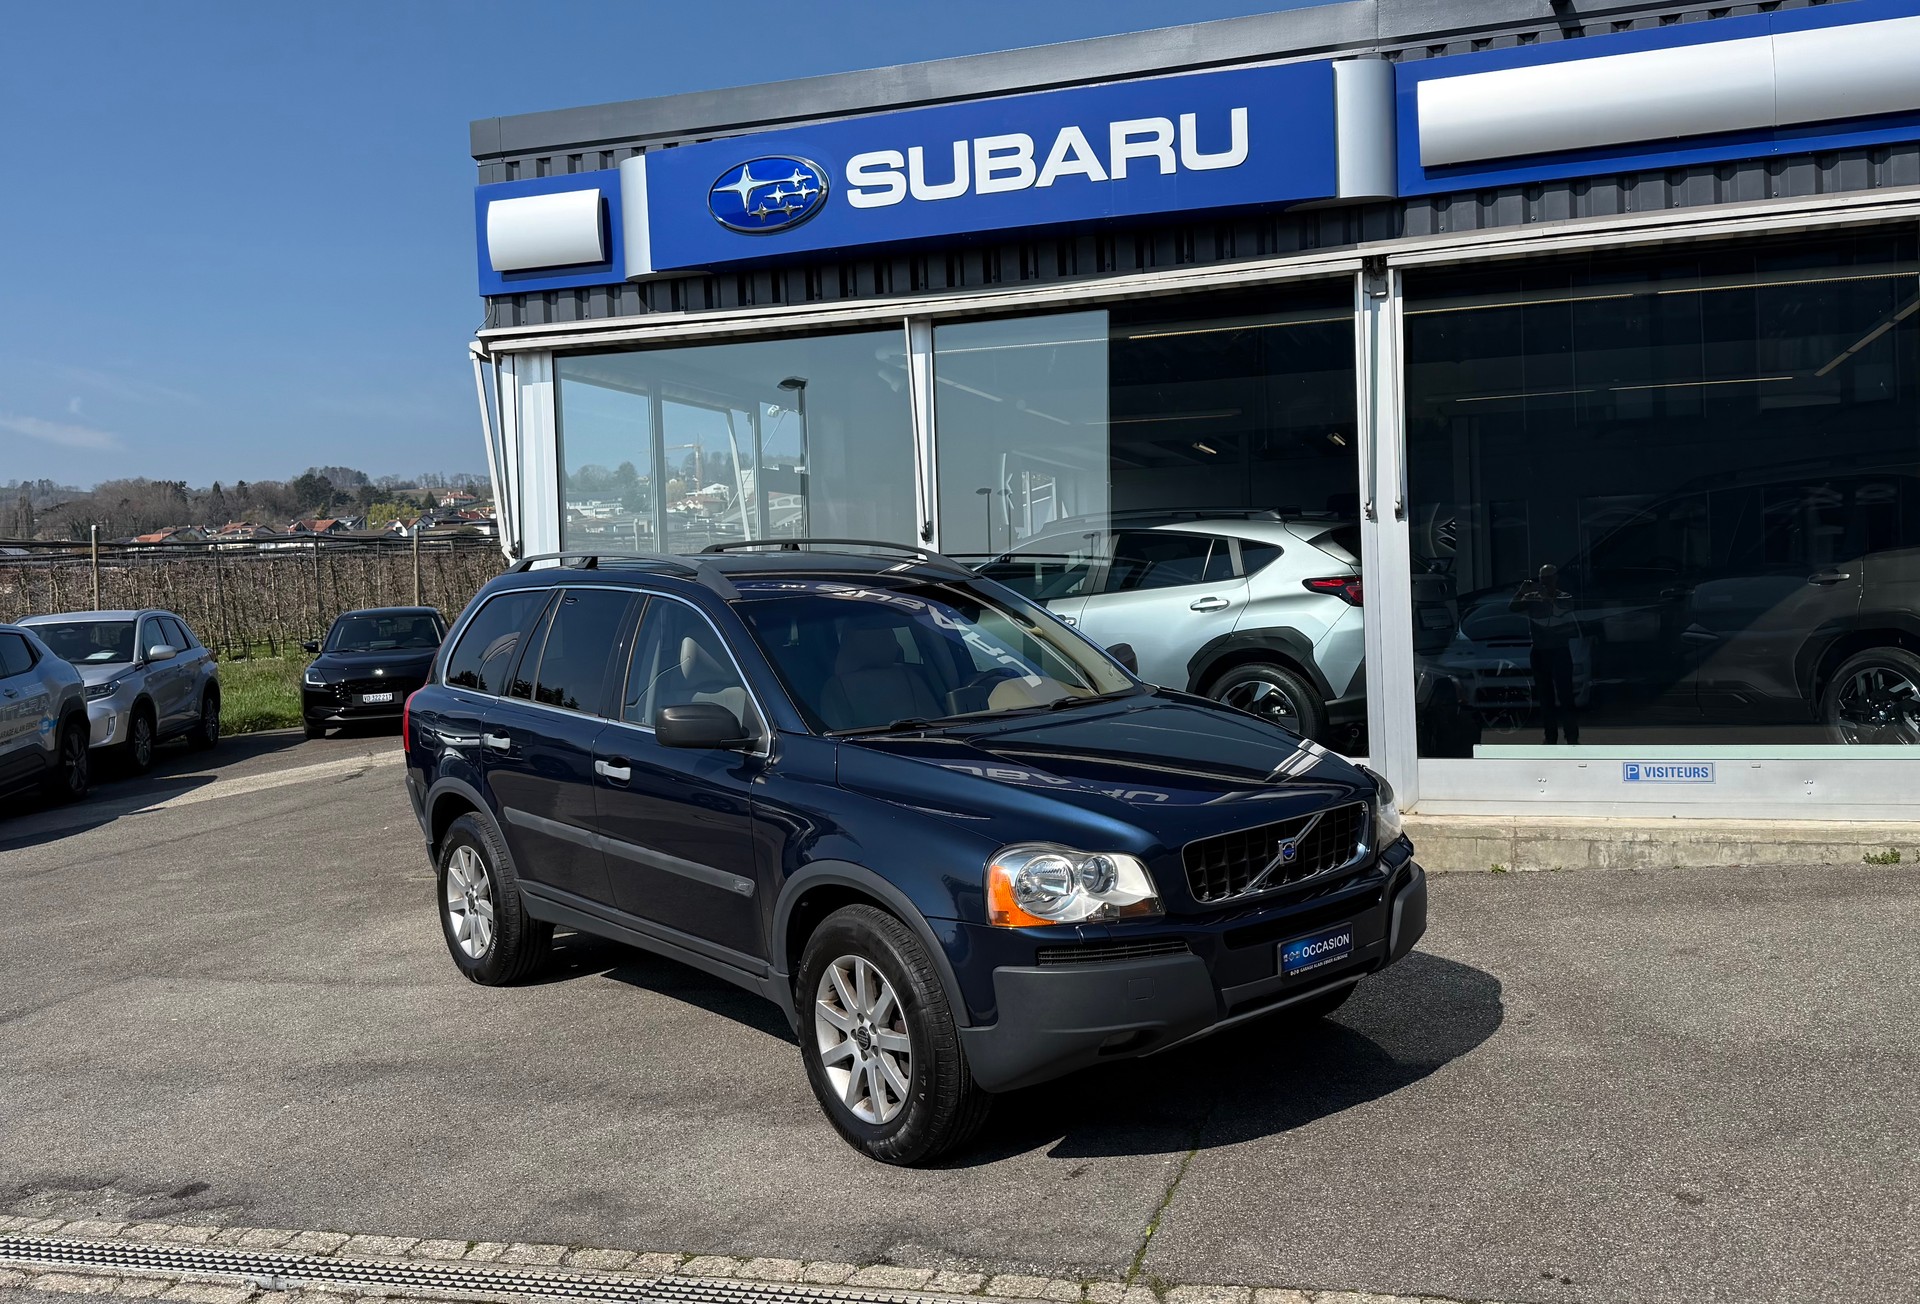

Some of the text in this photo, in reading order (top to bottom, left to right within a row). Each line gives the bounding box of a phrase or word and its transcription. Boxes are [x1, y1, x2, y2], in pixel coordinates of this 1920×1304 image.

[846, 107, 1249, 209] SUBARU
[1627, 765, 1709, 779] P VISITEURS
[1302, 933, 1350, 958] OCCASION
